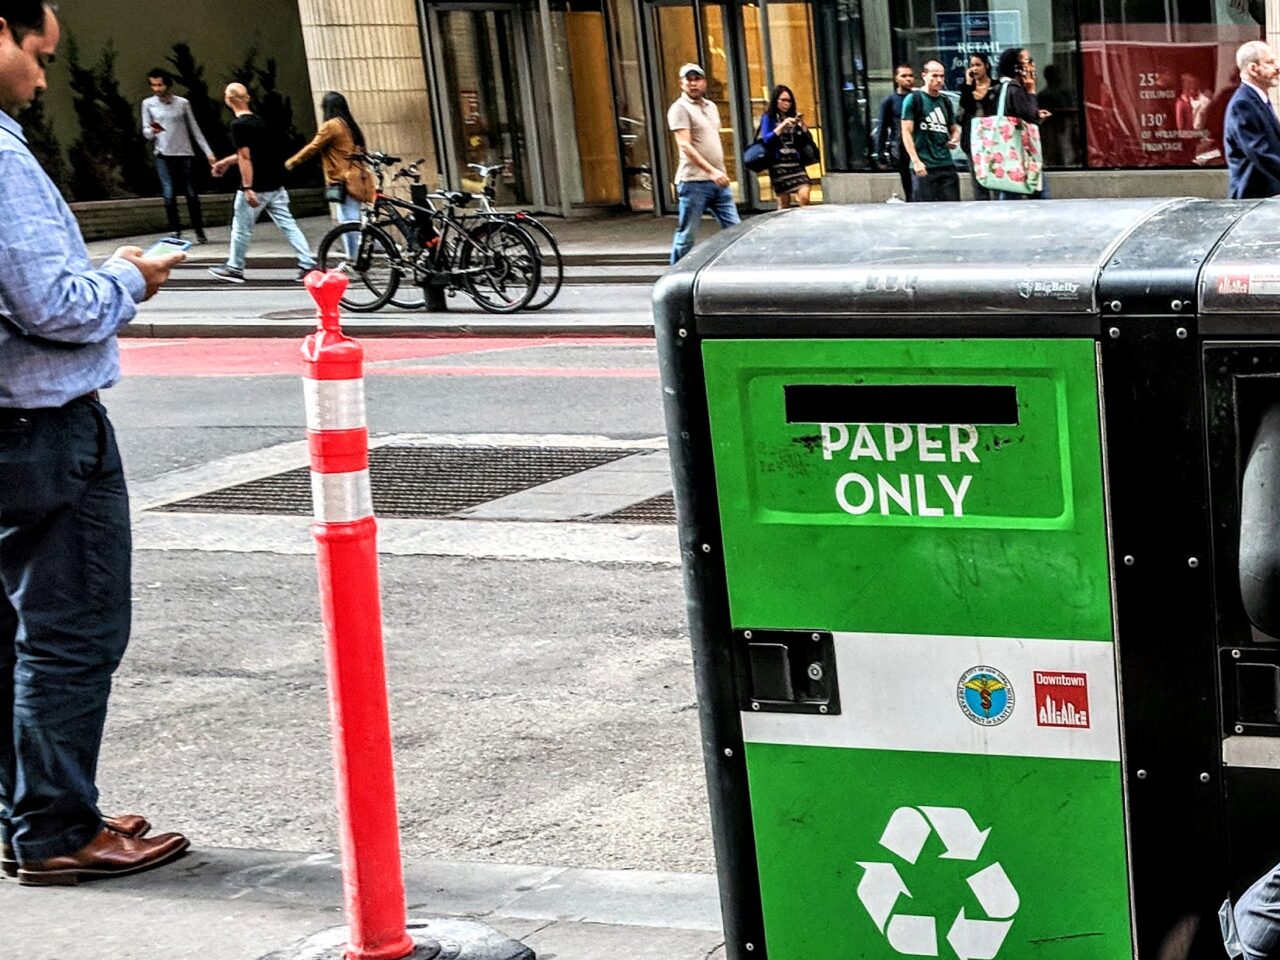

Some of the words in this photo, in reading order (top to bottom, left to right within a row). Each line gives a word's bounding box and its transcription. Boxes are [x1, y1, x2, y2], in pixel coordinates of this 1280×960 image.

[957, 41, 1000, 53] RETAIL
[1140, 90, 1176, 99] CEILINGS
[819, 423, 980, 463] PAPER
[835, 472, 973, 517] ONLY
[1036, 673, 1085, 686] Downtown
